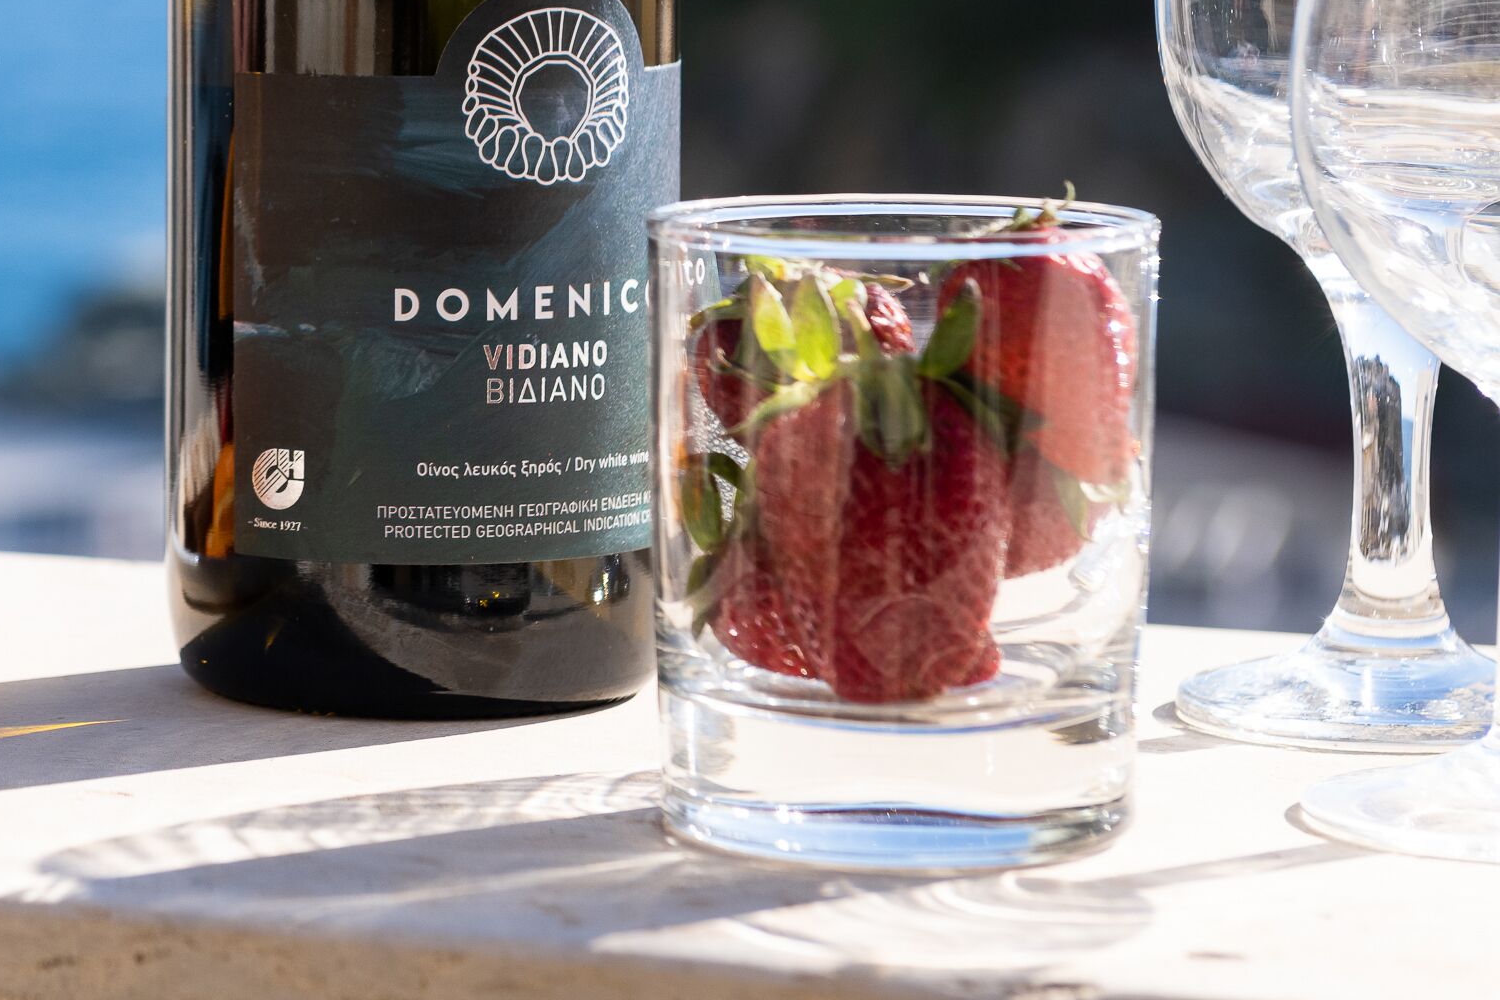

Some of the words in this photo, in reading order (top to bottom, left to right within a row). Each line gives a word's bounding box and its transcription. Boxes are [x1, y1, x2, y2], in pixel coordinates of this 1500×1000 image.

[394, 278, 650, 322] DOMENIC
[483, 339, 608, 370] VIDIANO
[486, 373, 606, 404] ΒΙΔΙΑΝΟ
[416, 461, 459, 479] Οίνος
[463, 460, 517, 478] λευκός
[520, 458, 562, 477] ξηρός
[574, 455, 596, 473] Dry
[598, 451, 628, 469] white
[629, 449, 650, 465] wine
[377, 505, 514, 519] ΠΡΟΣΤΑΤΕΥΟΜΕΝΗ
[519, 499, 598, 517] ΓΕΩΓΡΑΦΙΚΗ
[601, 492, 642, 511] ΕΝΔΕΙΞΗ
[384, 525, 471, 539] PROTECTED
[476, 521, 580, 538] GEOGRAPHICAL
[584, 512, 640, 531] INDICATION
